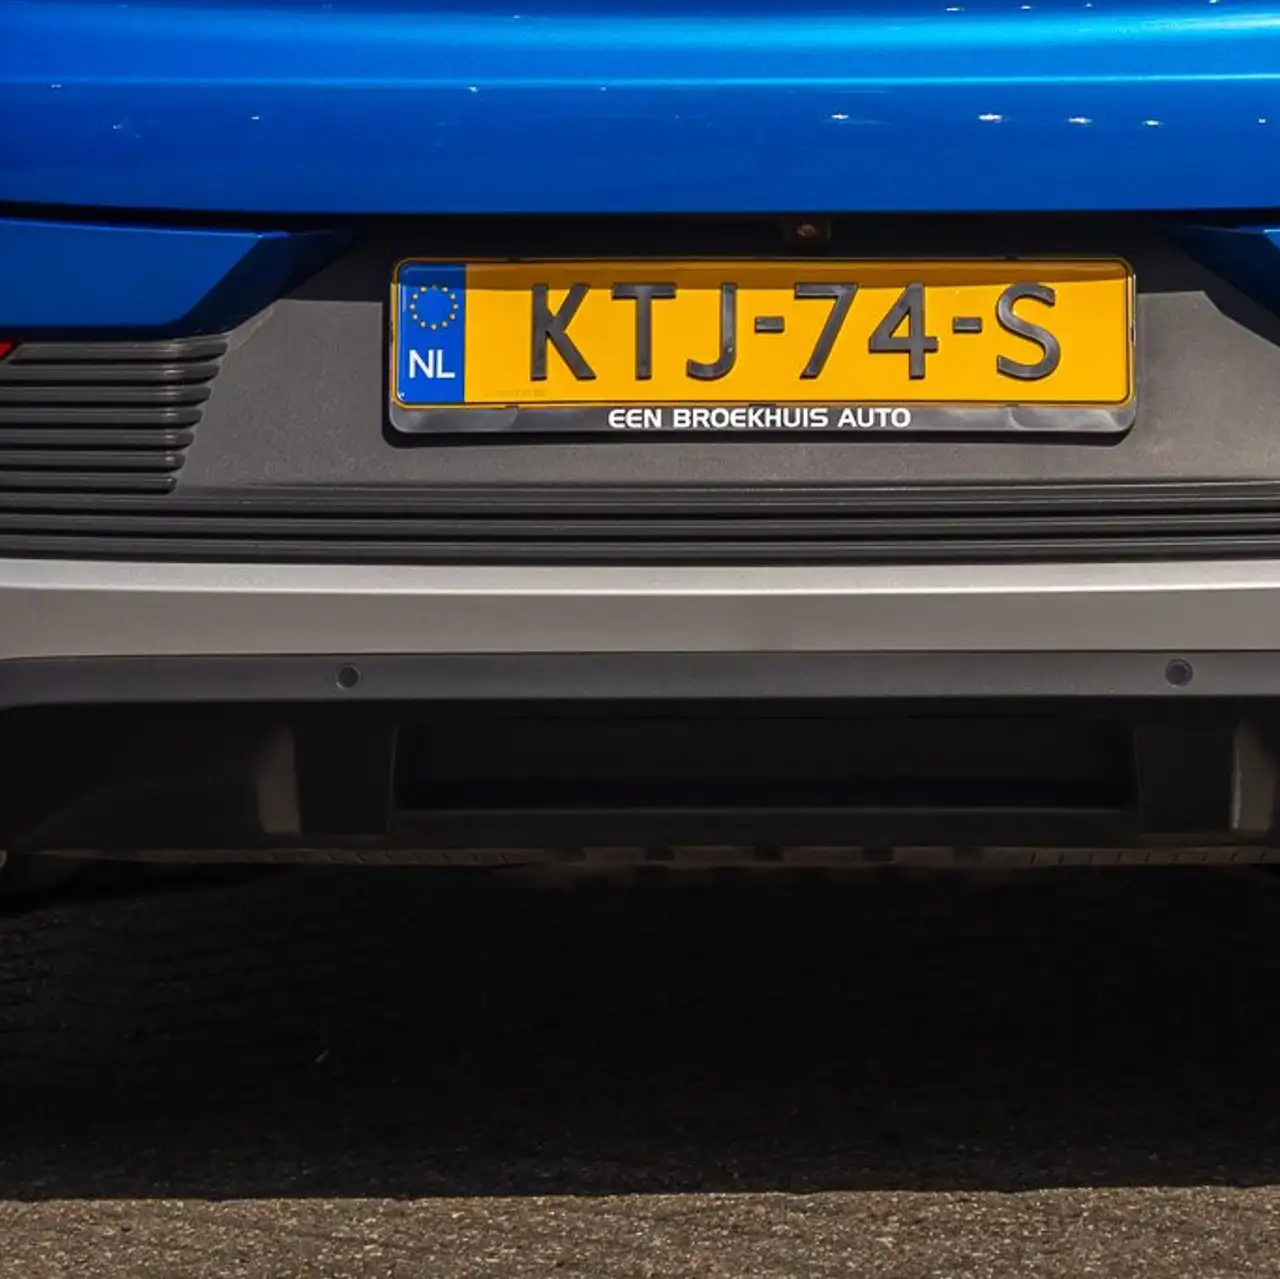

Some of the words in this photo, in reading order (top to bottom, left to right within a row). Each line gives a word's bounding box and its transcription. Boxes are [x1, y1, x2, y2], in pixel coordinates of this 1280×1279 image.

[530, 282, 1062, 381] KTJ-74-S
[408, 348, 456, 379] NL
[607, 408, 662, 428] EEN
[673, 407, 828, 428] BROEKHUIS
[837, 407, 912, 428] AUTO
